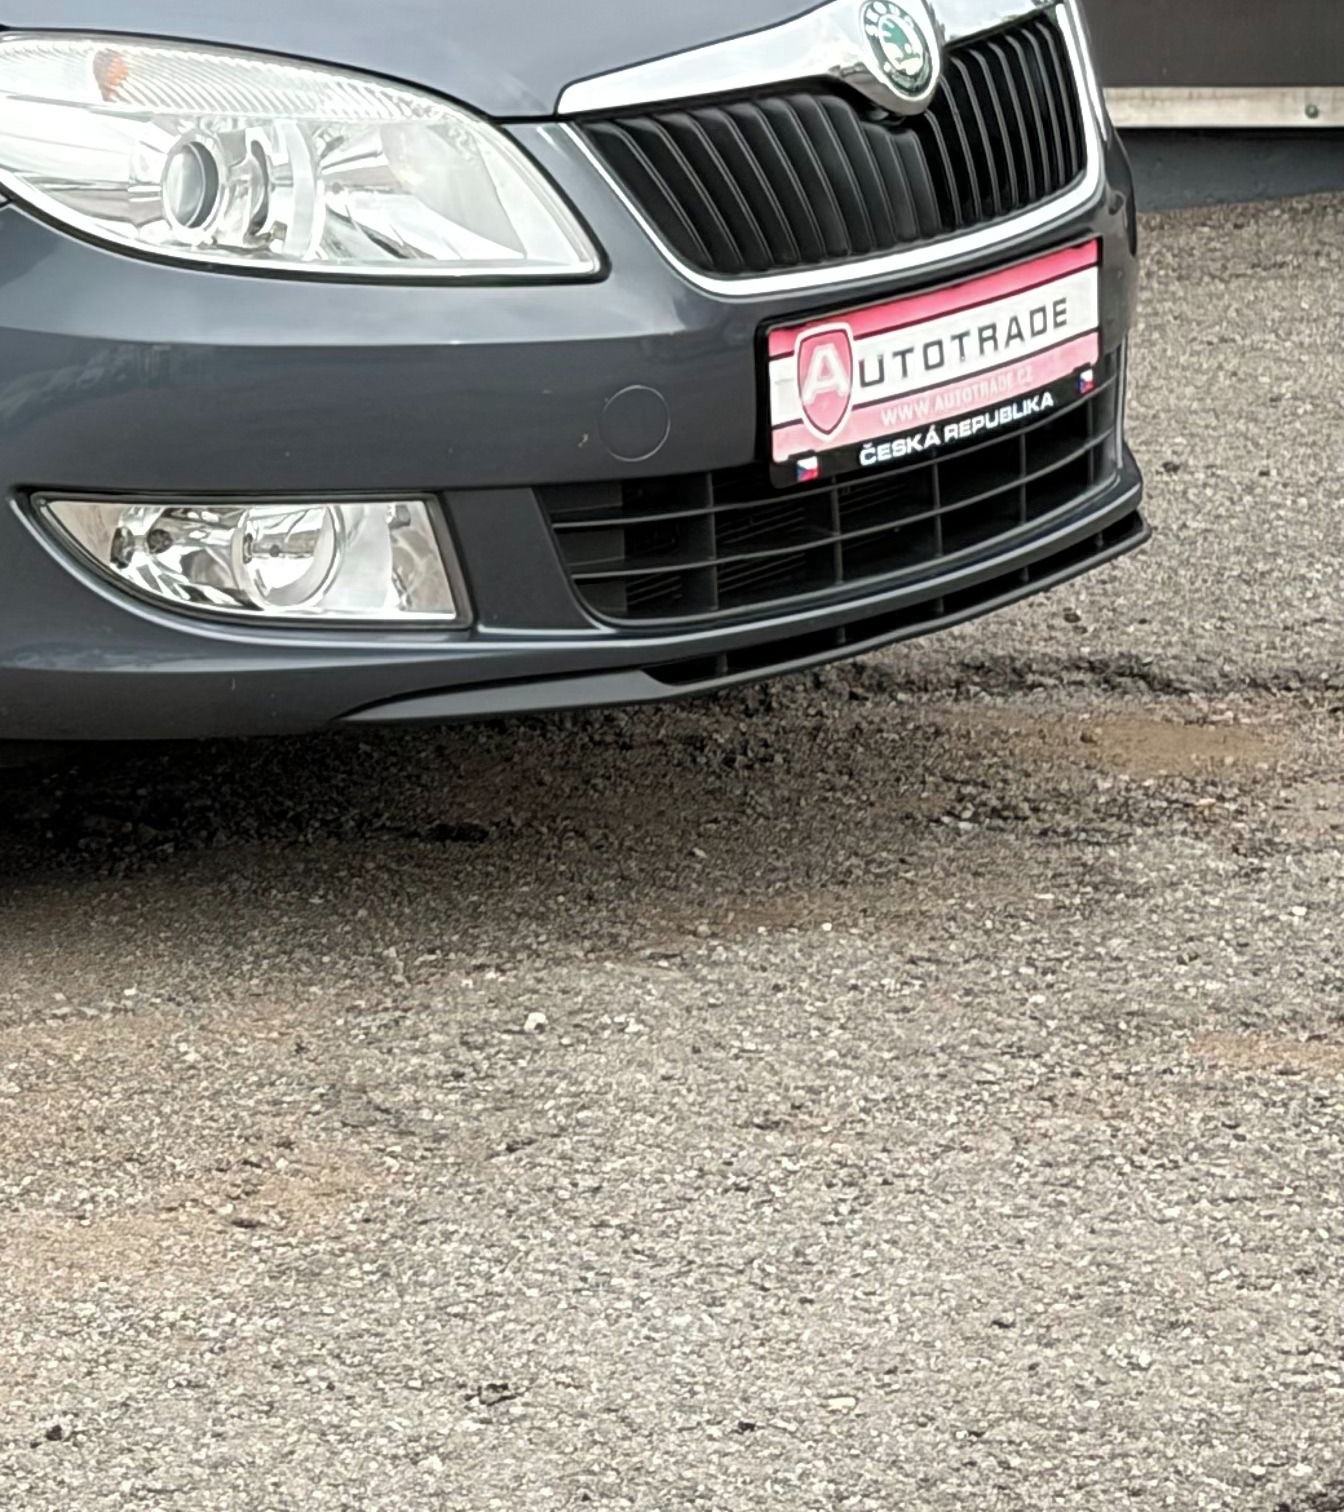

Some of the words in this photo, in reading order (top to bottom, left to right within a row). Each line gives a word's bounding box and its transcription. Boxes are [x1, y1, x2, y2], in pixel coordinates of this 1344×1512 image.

[801, 298, 1067, 405] AUTOTRADE
[859, 424, 941, 467] ČESKÁ
[944, 391, 1054, 444] REPUBLIKA
